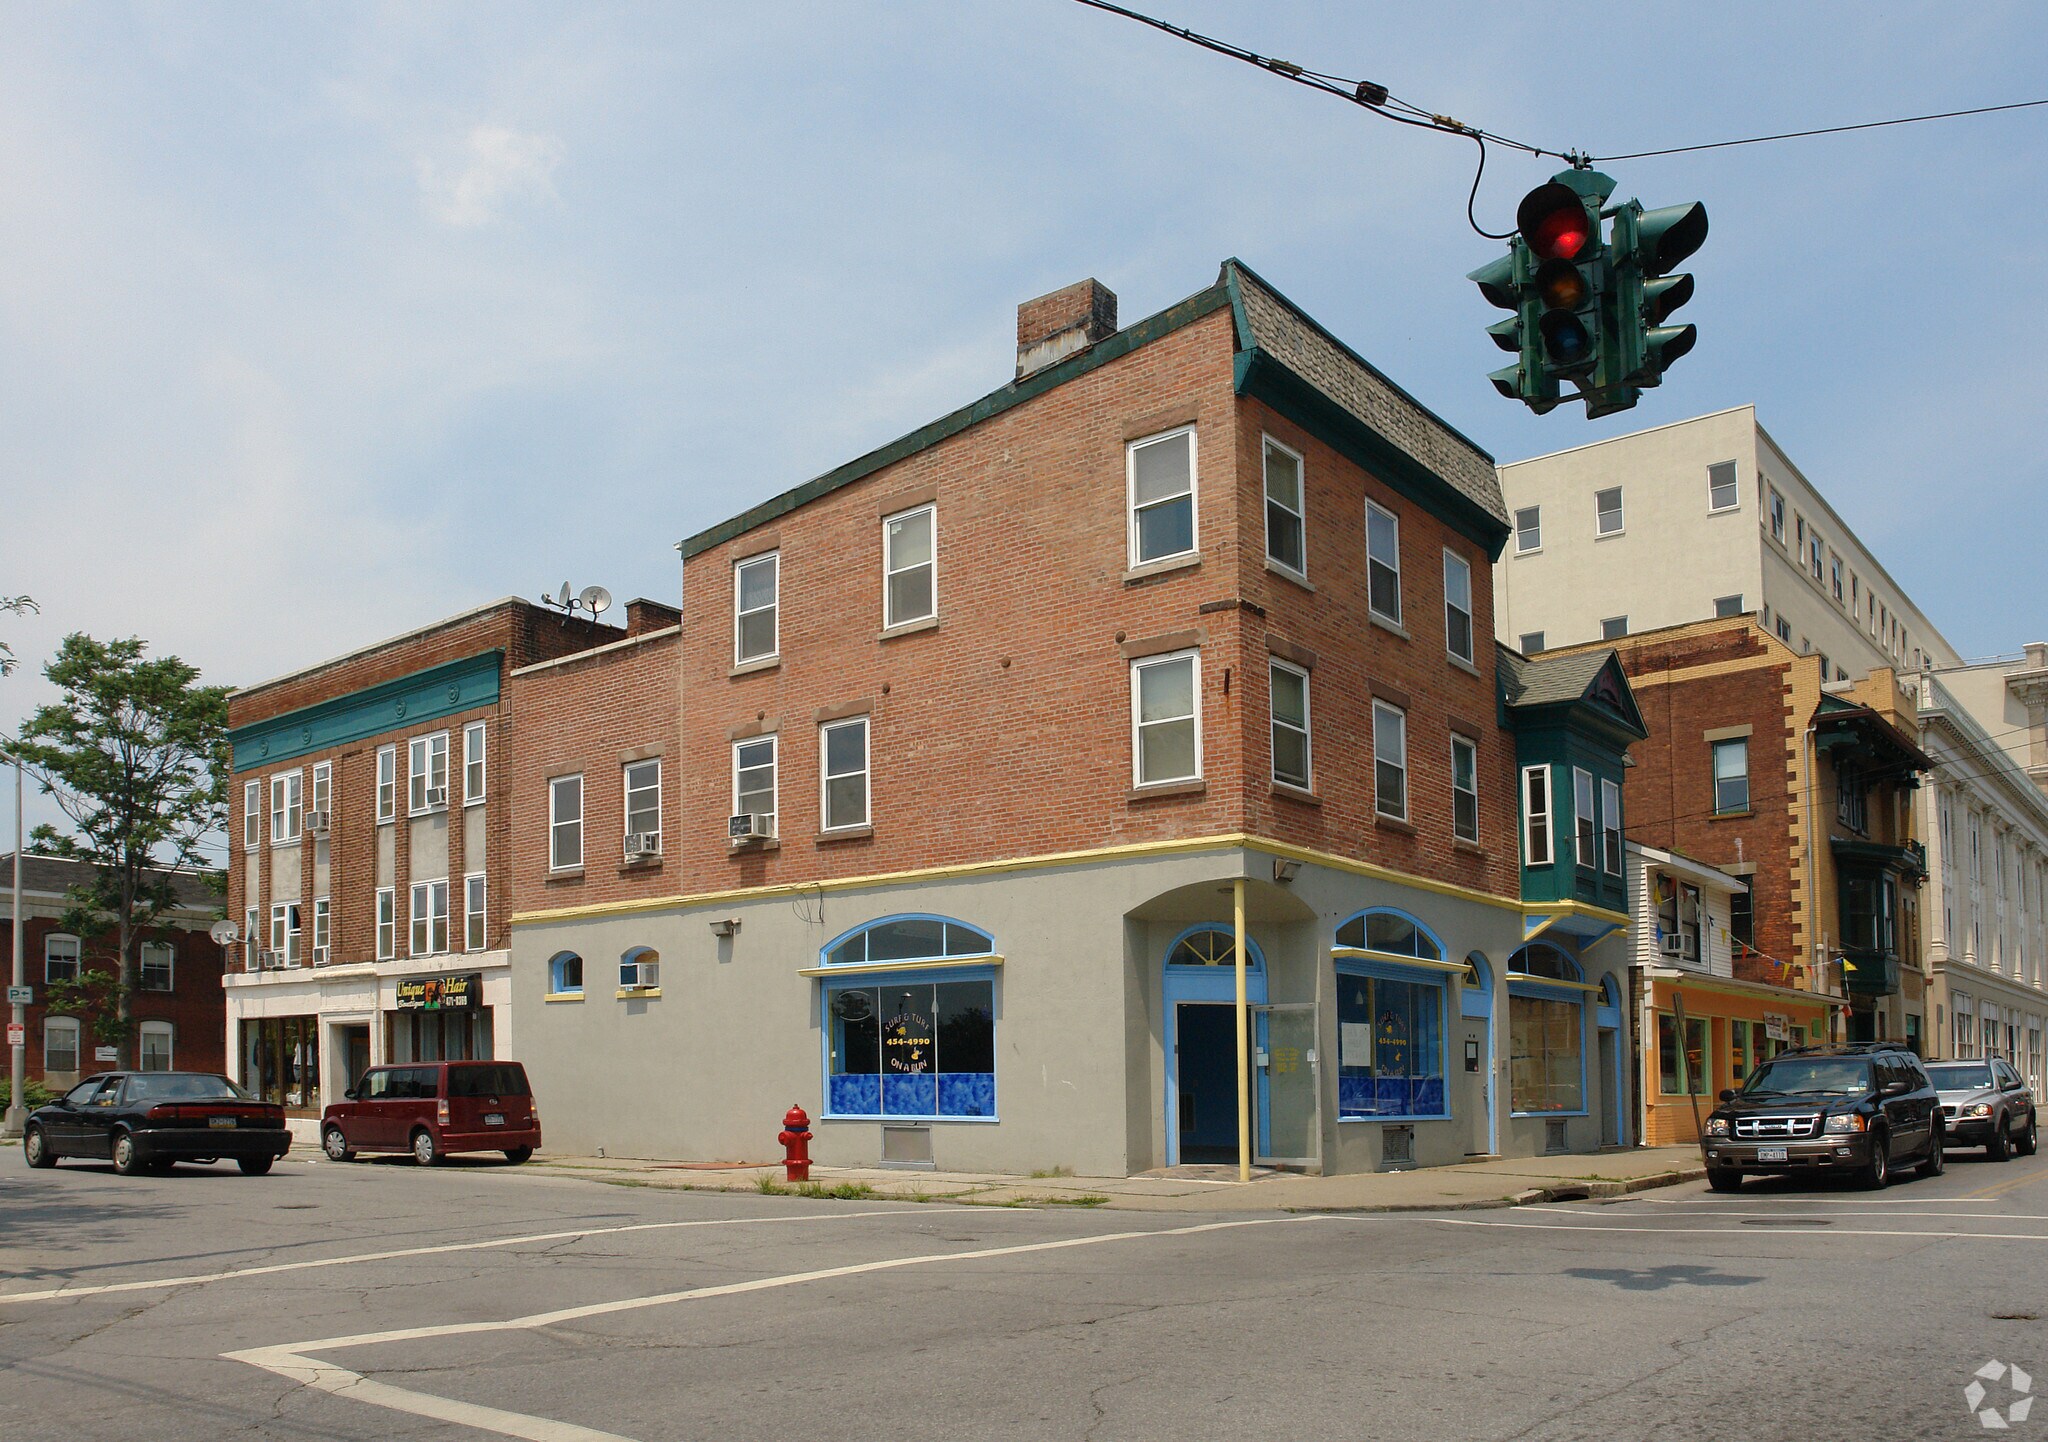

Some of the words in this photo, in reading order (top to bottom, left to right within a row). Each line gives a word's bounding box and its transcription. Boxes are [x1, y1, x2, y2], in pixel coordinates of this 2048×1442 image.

[10, 990, 20, 999] P
[397, 981, 425, 1001] Unique
[445, 977, 468, 994] Hair
[885, 1014, 902, 1032] SURF
[911, 1013, 929, 1030] TURF
[886, 1038, 930, 1046] 454-4990
[1378, 1037, 1407, 1047] 454-4990
[890, 1058, 903, 1070] ON
[903, 1063, 910, 1072] A
